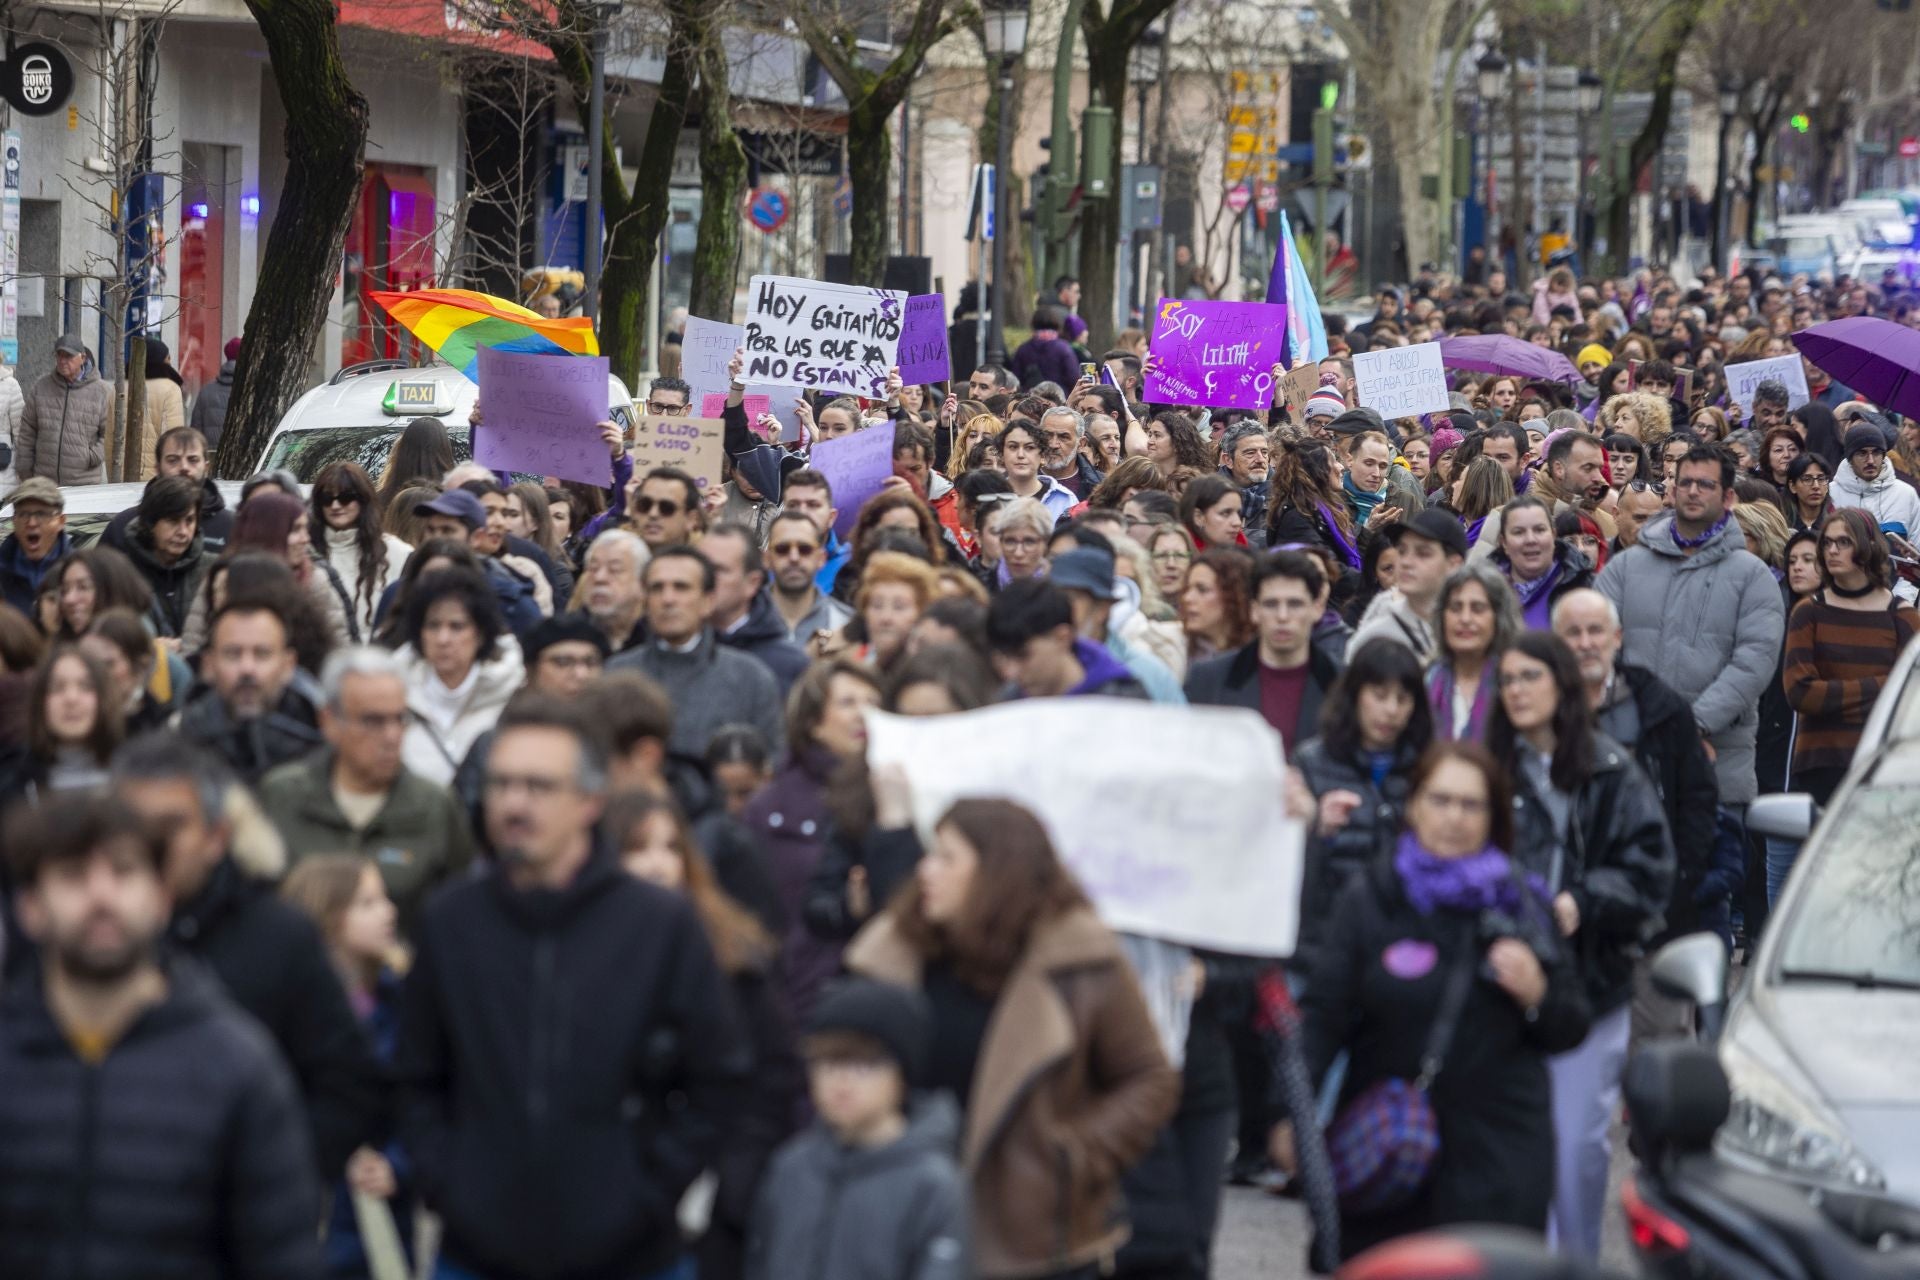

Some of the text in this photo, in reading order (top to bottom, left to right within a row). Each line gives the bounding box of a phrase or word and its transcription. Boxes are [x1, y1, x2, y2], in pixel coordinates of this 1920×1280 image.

[23, 74, 52, 87] GOIKO
[757, 281, 807, 325] HOY
[1159, 307, 1206, 341] SOY
[746, 322, 887, 366] POR LAS QUE YA
[1202, 342, 1250, 367] LILITH
[750, 356, 788, 379] NO
[1389, 351, 1420, 371] ABUSO
[402, 386, 434, 402] TAXI
[1362, 377, 1402, 395] ESTABA
[1399, 390, 1415, 409] DE
